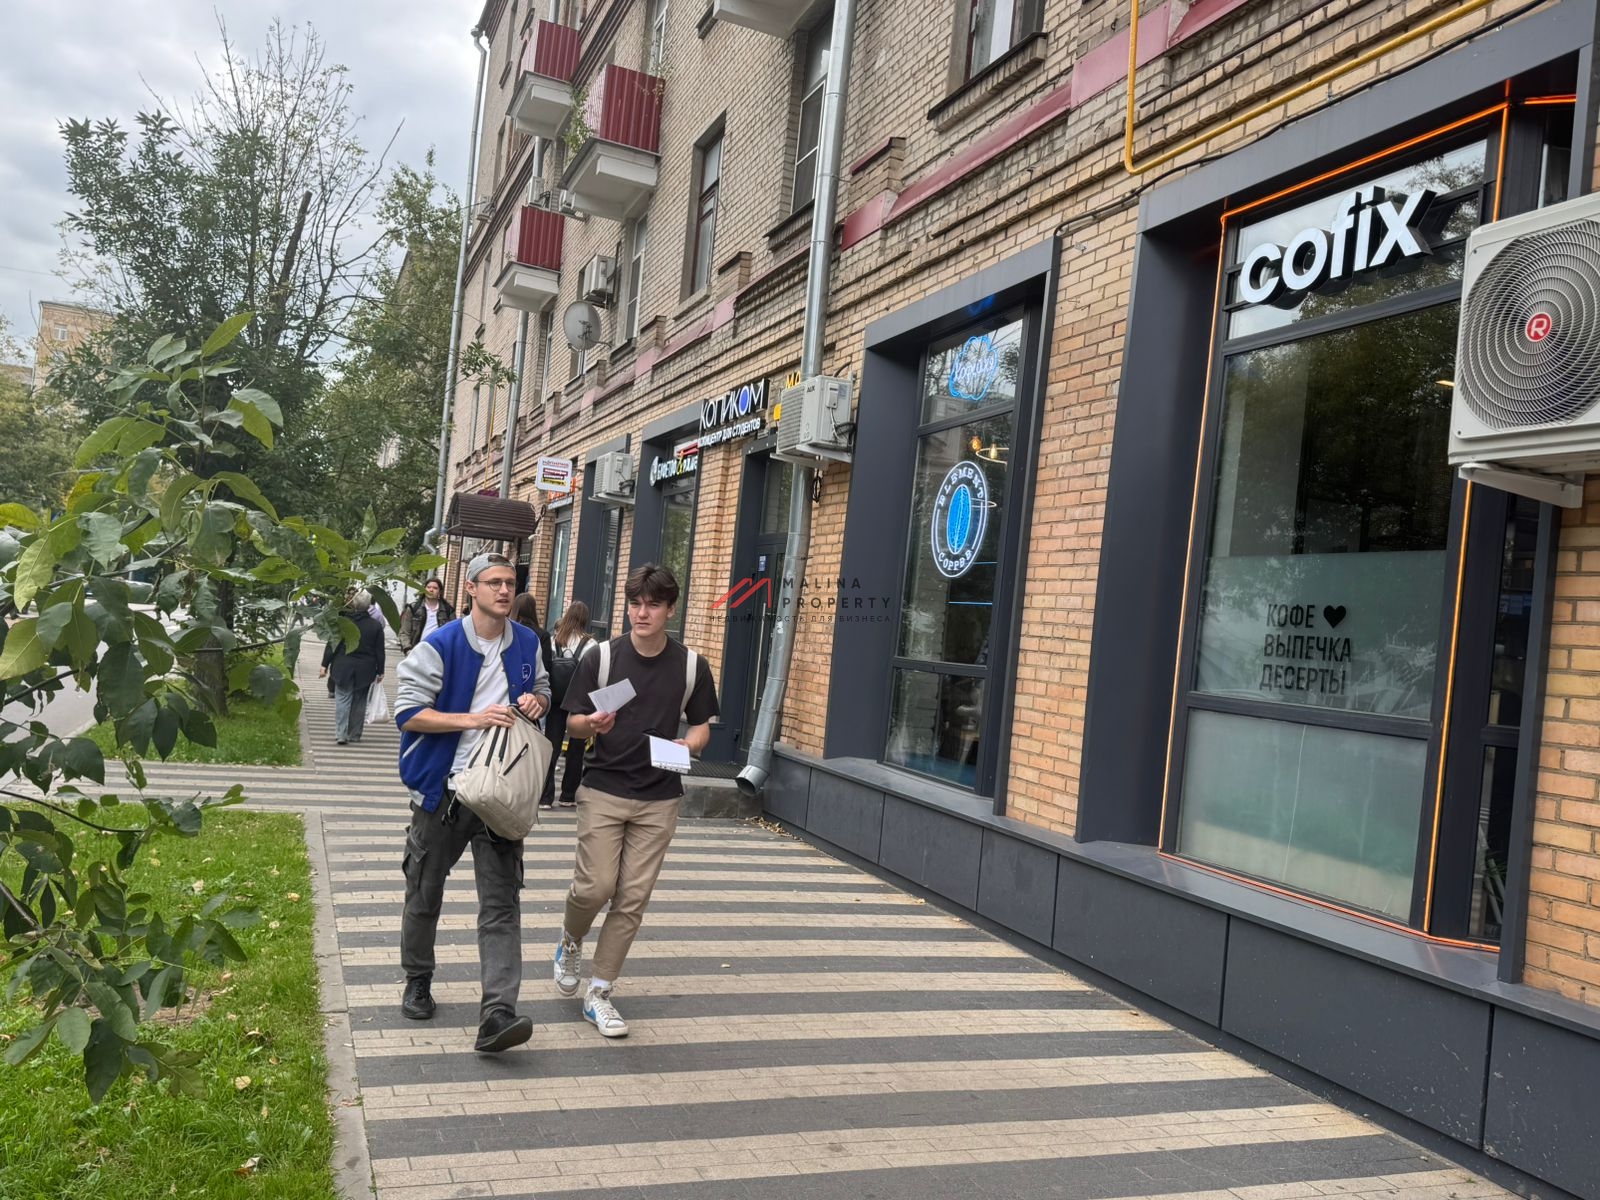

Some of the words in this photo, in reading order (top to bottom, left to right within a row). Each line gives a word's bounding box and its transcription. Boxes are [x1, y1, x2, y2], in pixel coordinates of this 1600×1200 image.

[1240, 186, 1430, 303] cofix
[700, 378, 765, 431] КОПИКОМ
[1266, 603, 1316, 629] КОФЕ
[1263, 633, 1352, 663] ВЫПЕЧКА
[1259, 664, 1347, 696] ДЕСЕРТЫ
